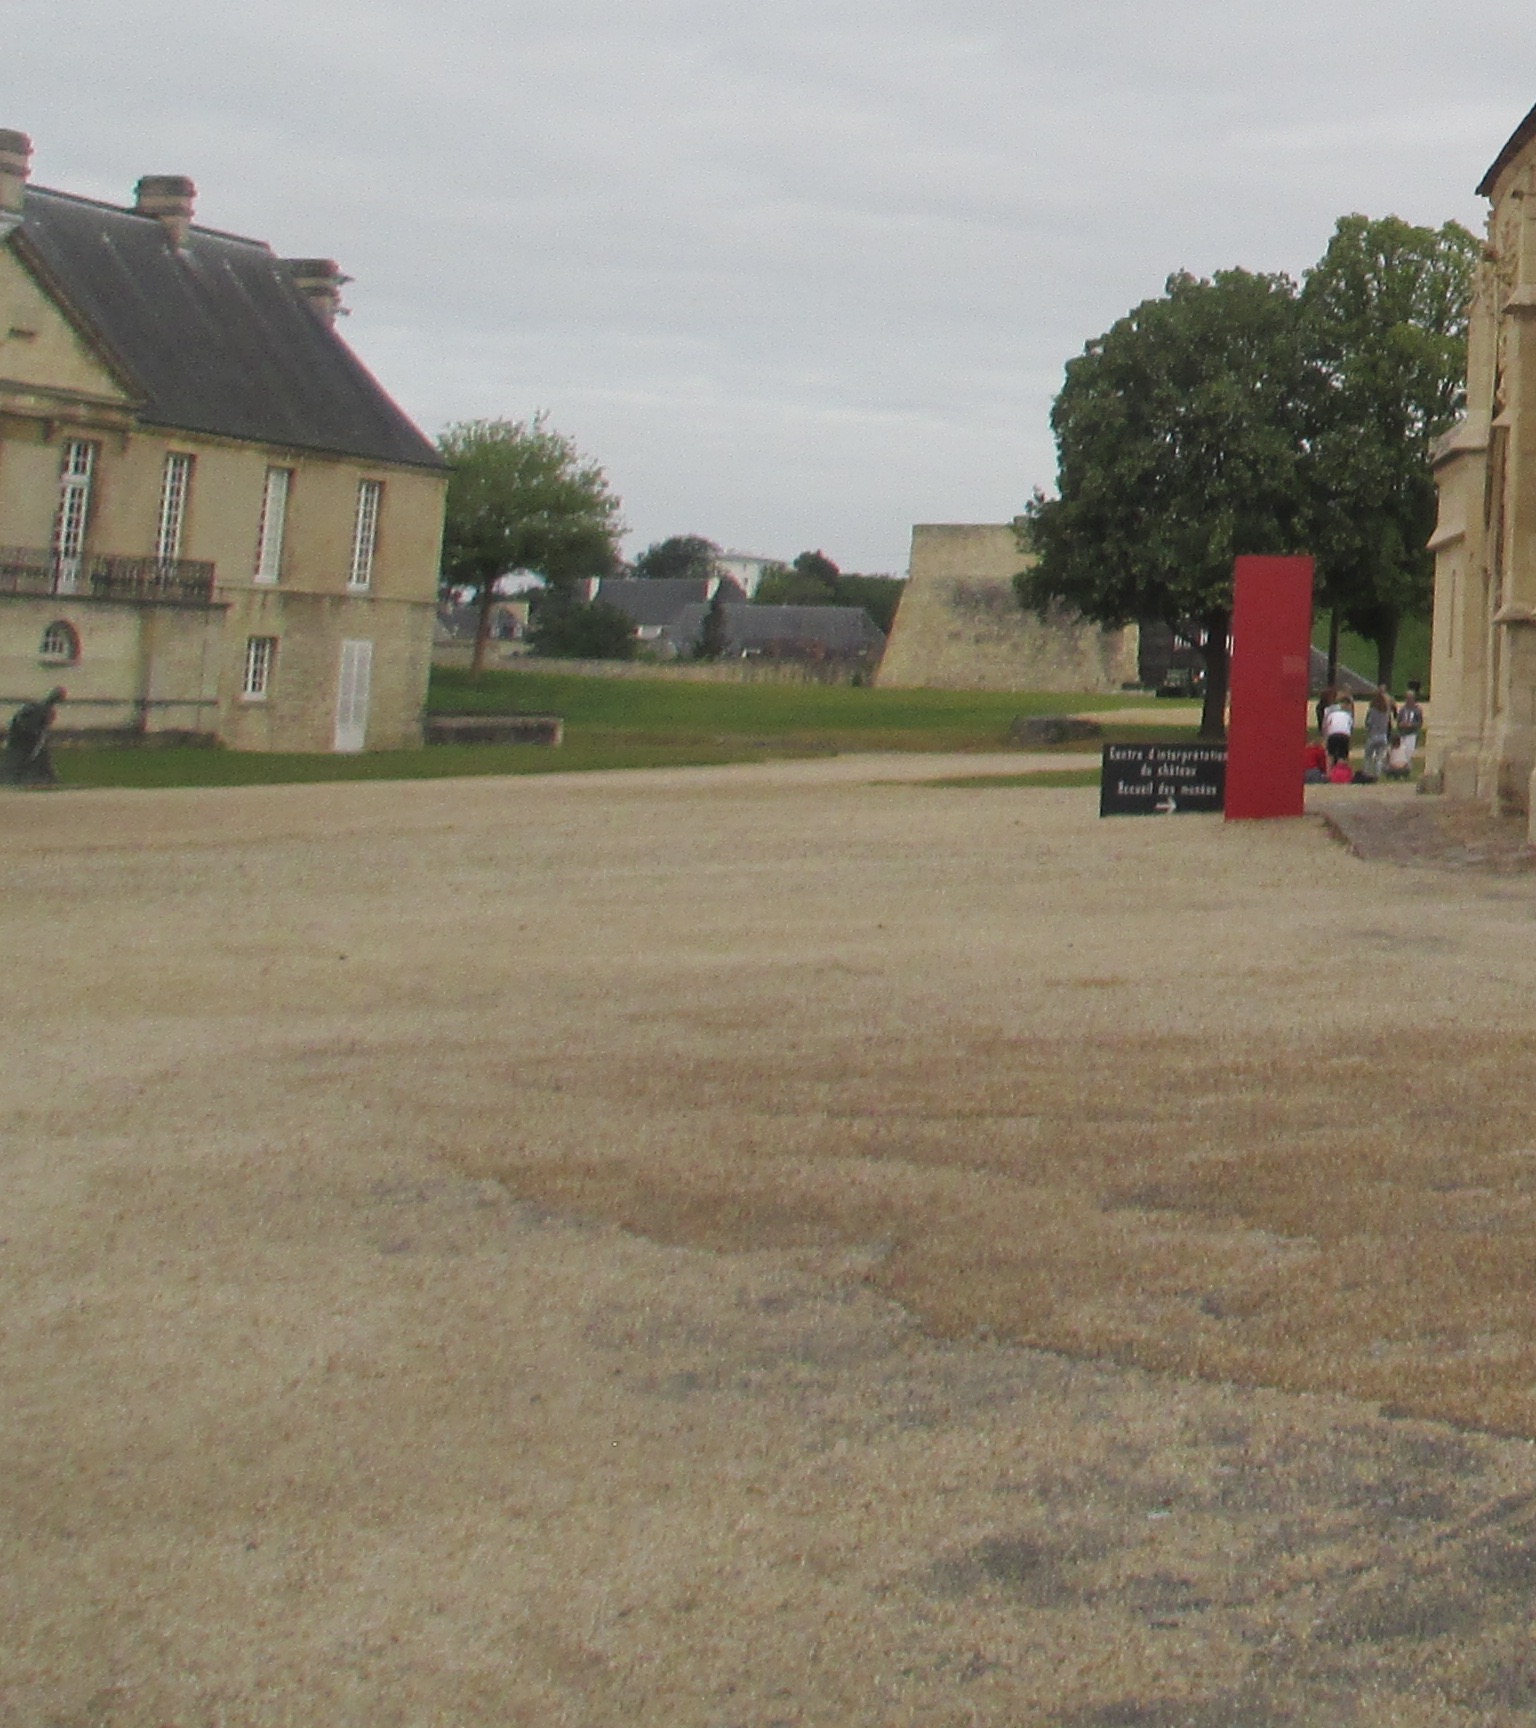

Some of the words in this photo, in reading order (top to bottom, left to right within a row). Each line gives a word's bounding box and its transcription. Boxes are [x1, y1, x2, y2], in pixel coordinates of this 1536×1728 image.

[1109, 746, 1143, 761] Centre
[1140, 763, 1152, 776] du
[1117, 779, 1154, 795] Accueil
[1158, 782, 1175, 795] des
